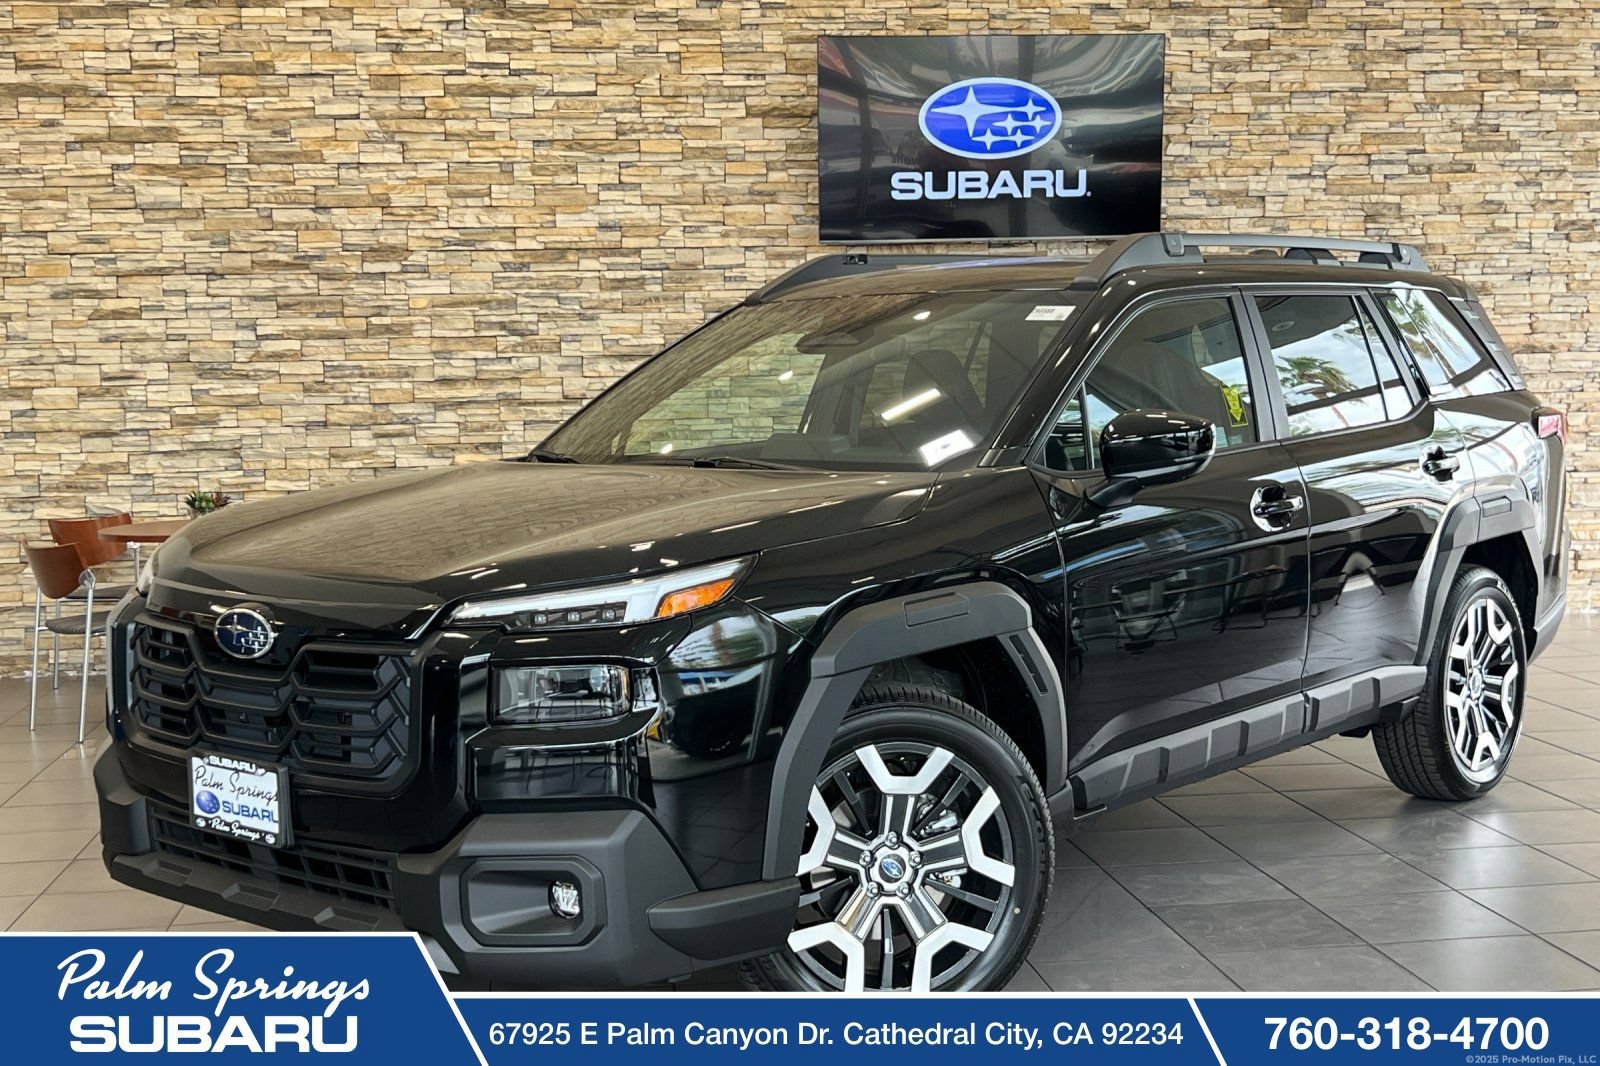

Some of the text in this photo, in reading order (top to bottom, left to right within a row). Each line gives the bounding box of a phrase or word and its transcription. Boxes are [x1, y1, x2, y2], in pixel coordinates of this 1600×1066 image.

[208, 755, 257, 772] SUBARU
[194, 765, 224, 790] Palm
[211, 818, 261, 841] Palm Springs
